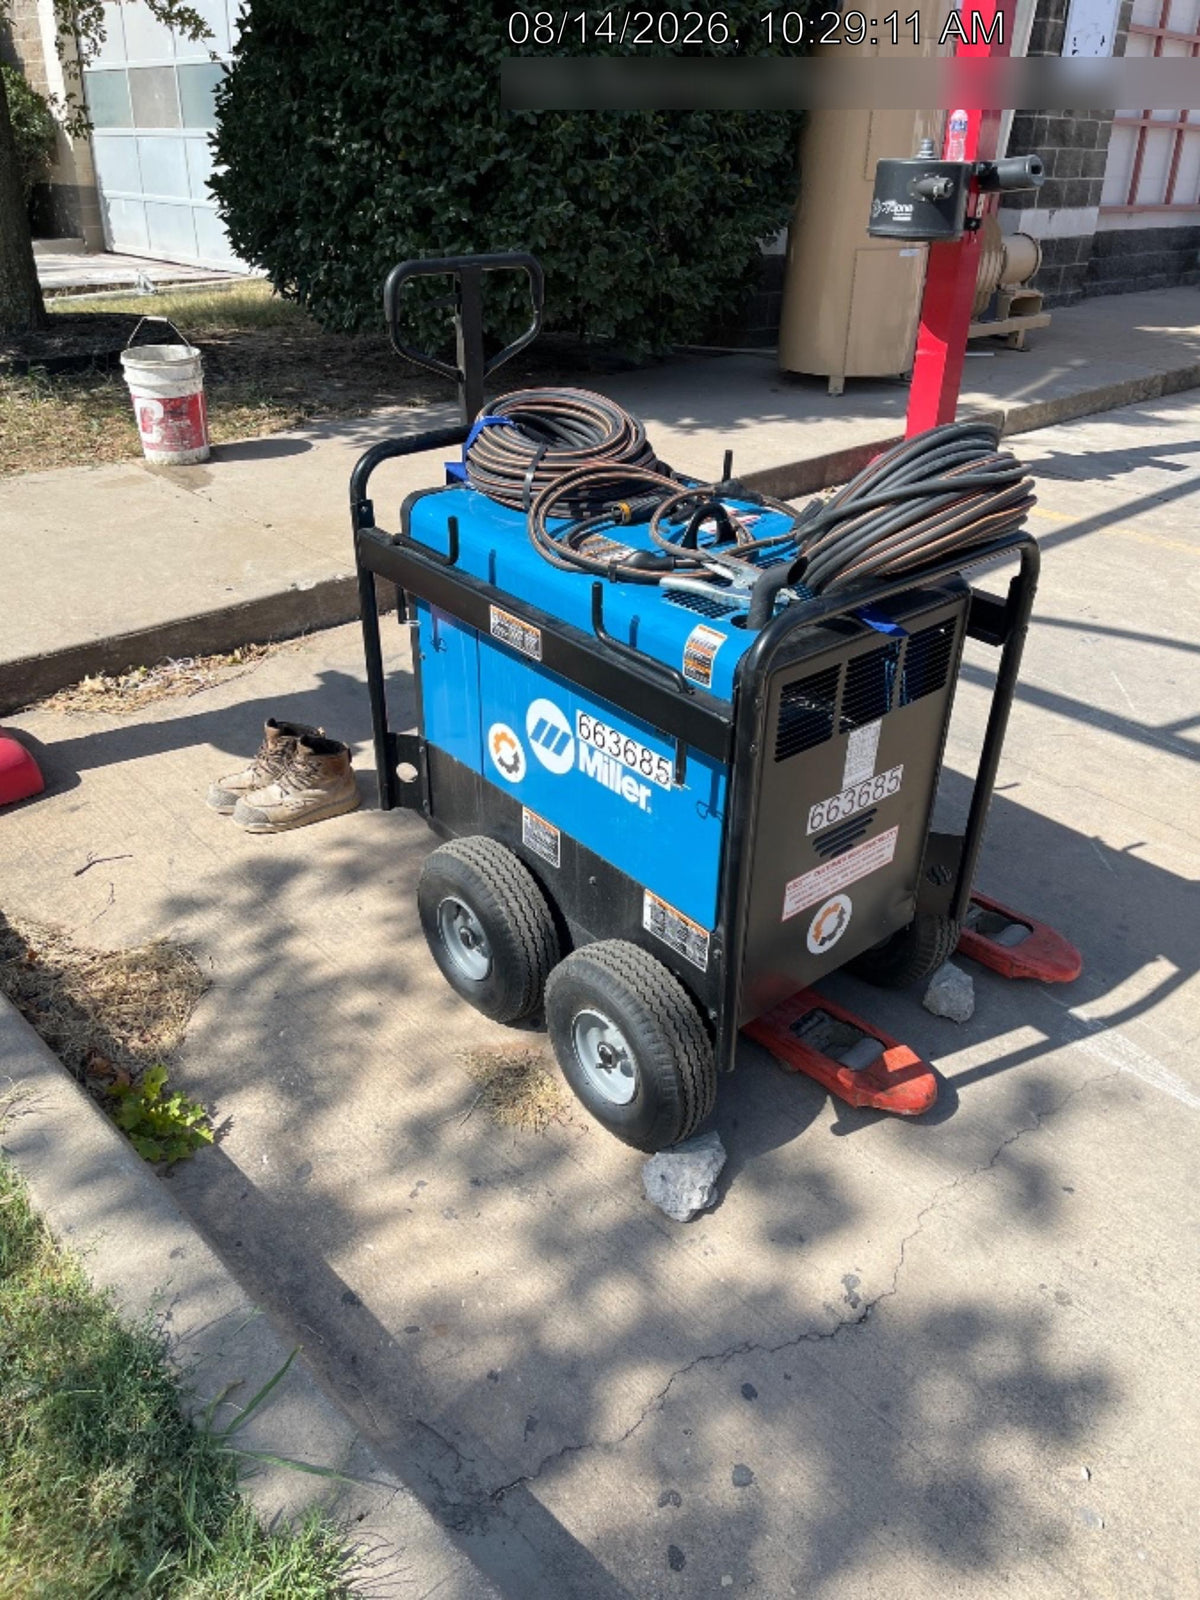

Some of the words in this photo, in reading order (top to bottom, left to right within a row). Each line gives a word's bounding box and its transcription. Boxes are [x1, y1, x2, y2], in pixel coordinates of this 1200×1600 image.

[579, 713, 670, 785] 663685
[579, 741, 652, 812] Miller
[810, 766, 901, 829] 663685
